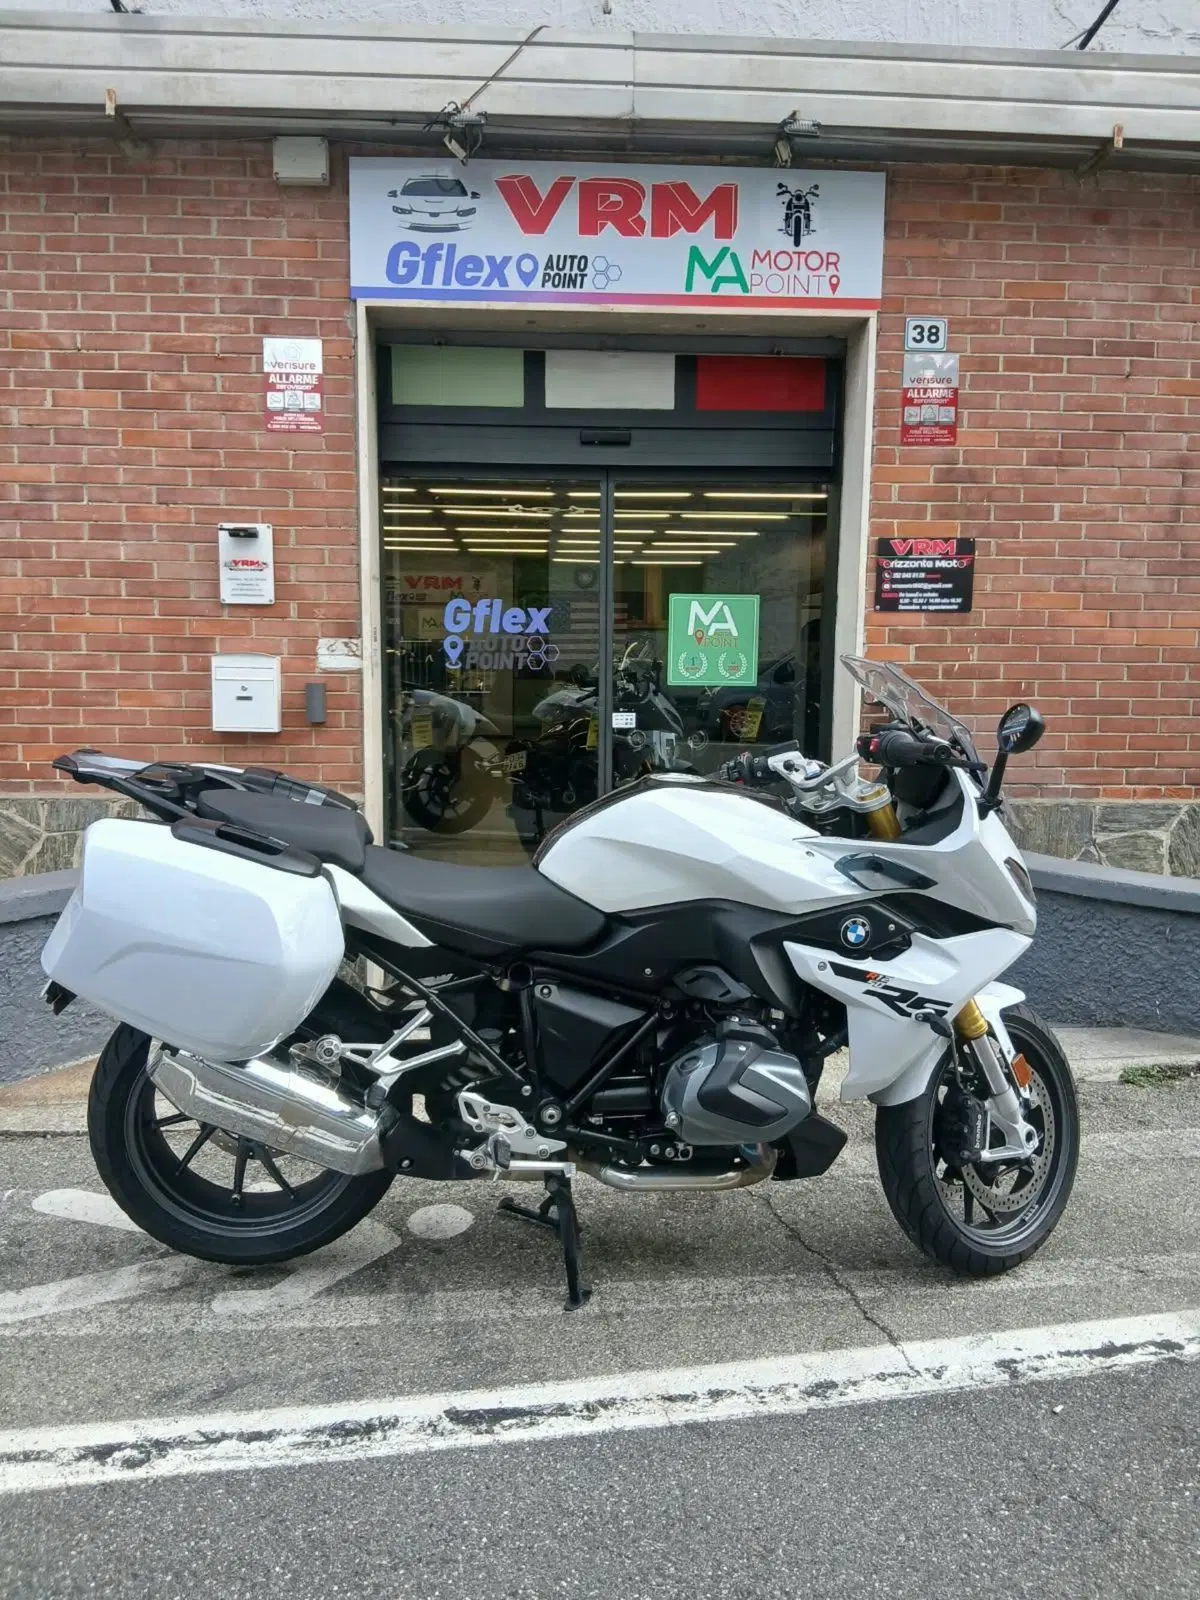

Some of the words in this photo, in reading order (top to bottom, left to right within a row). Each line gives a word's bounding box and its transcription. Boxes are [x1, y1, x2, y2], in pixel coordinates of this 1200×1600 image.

[494, 174, 739, 239] VRM
[386, 241, 513, 287] Gflex
[544, 254, 588, 272] AUTO
[685, 245, 749, 293] MA
[752, 249, 840, 272] MOTOR
[541, 273, 588, 289] POINT
[750, 273, 826, 295] POINT
[911, 324, 940, 344] 38
[269, 374, 319, 384] ALLARME
[909, 376, 952, 385] verisure
[907, 389, 954, 398] ALLARME
[890, 539, 957, 555] VRM
[404, 576, 463, 590] VRM
[443, 599, 552, 634] Gflex
[687, 601, 738, 636] MA
[469, 635, 526, 651] AUTO
[466, 652, 530, 670] POINT
[974, 1113, 982, 1149] brembo
